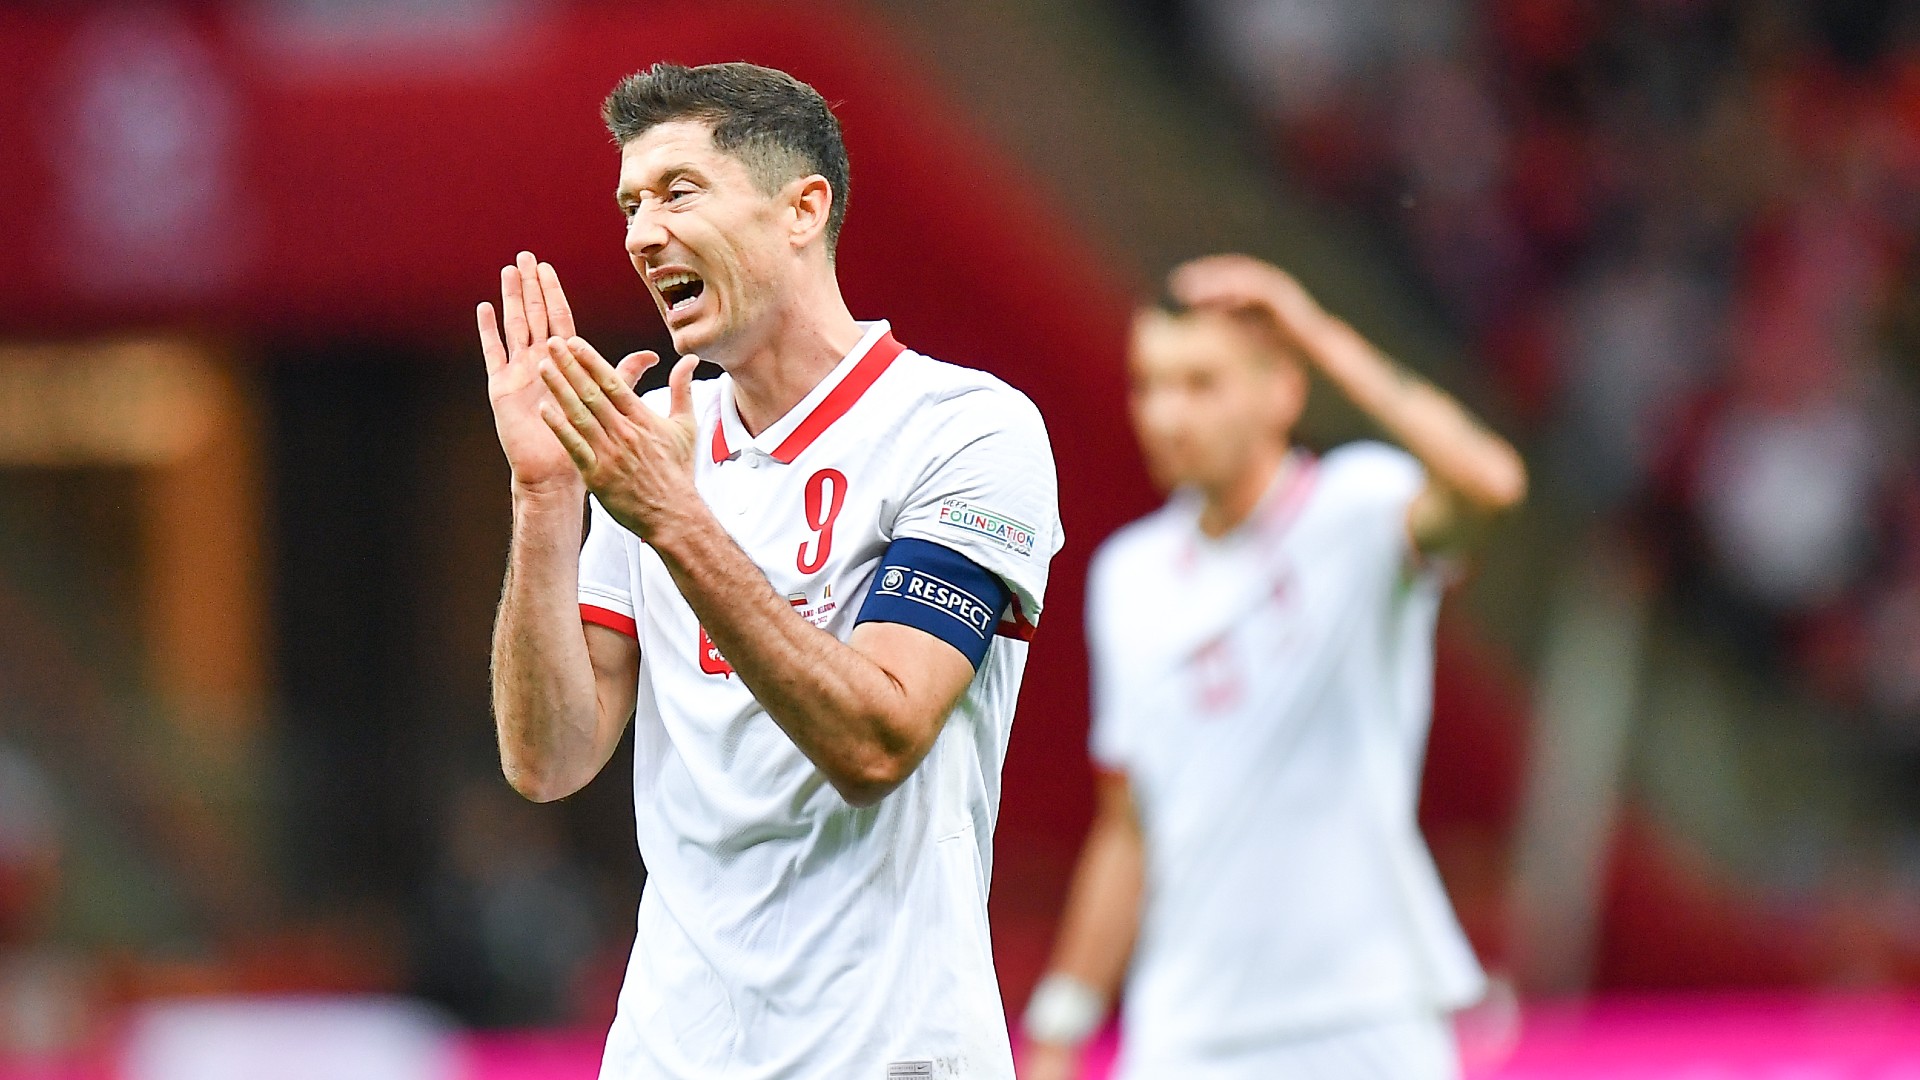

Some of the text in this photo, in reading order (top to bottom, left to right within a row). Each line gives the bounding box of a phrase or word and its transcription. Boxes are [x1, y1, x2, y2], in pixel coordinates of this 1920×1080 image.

[797, 468, 847, 575] 9
[940, 507, 1035, 548] FOUNDATION
[943, 499, 968, 508] UEFA
[908, 576, 991, 631] RESPECT
